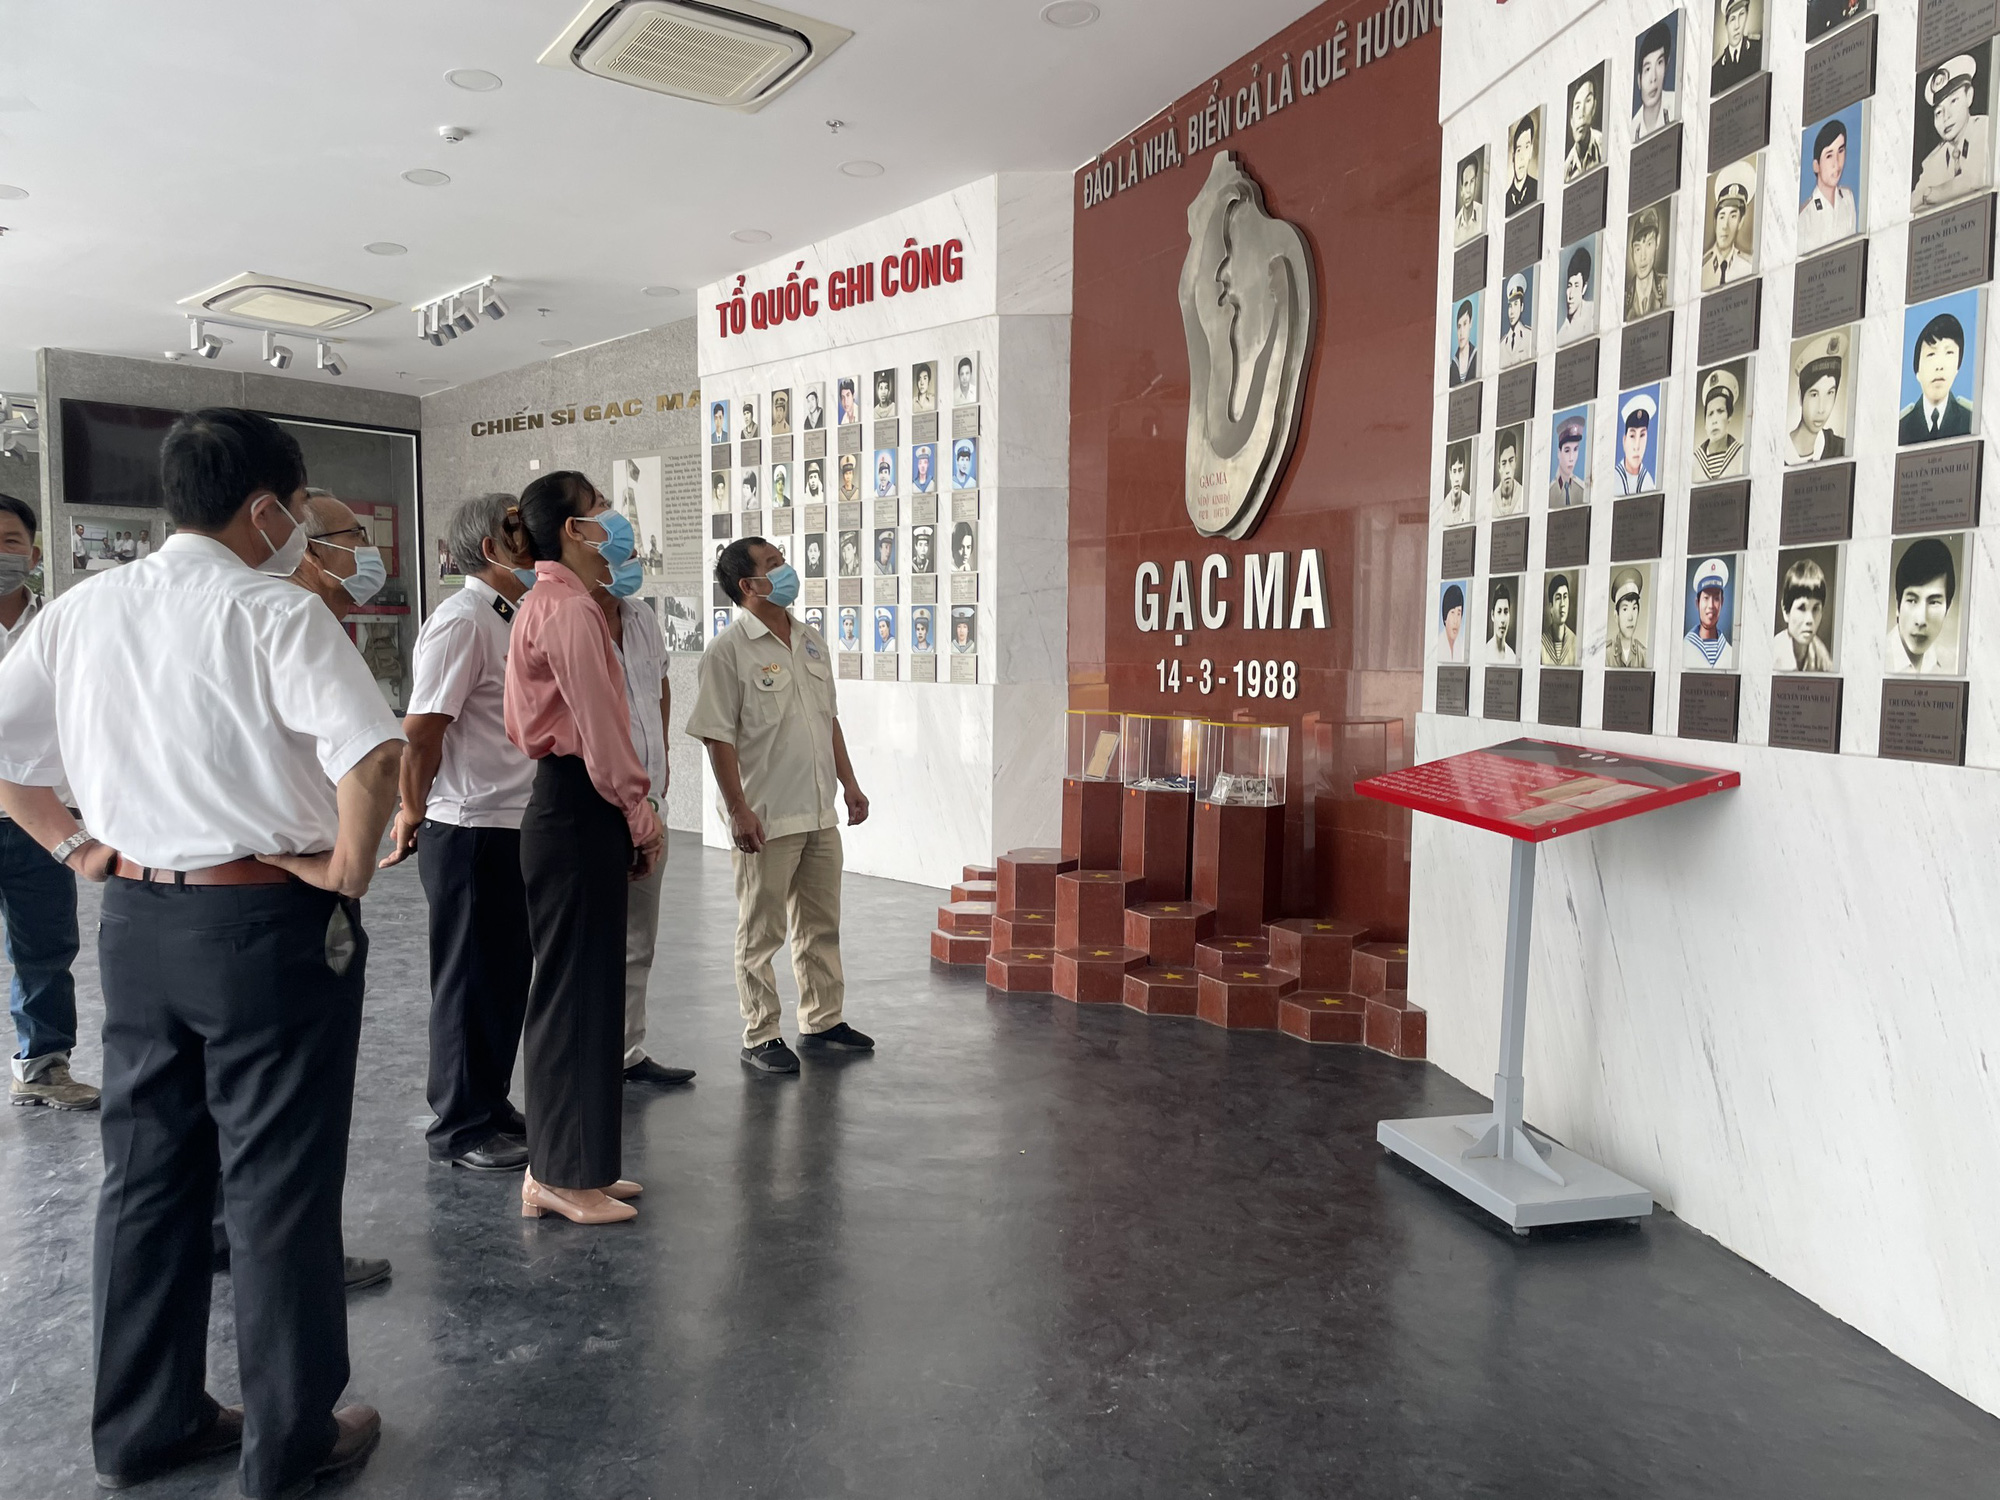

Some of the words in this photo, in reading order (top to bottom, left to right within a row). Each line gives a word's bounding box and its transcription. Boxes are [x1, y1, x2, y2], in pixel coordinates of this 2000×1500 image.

[1083, 153, 1114, 209] ĐẢO
[1117, 137, 1139, 191] LÀ
[1188, 78, 1232, 156] BIỂN
[1235, 62, 1262, 131] CẢ
[1266, 52, 1294, 116] LÀ
[1300, 20, 1349, 96] QUÊ
[715, 274, 747, 338] TỔ
[751, 260, 819, 330] QUỐC
[827, 261, 875, 312] GHI
[881, 237, 964, 297] CÔNG
[471, 405, 545, 437] CHIẾN
[551, 402, 578, 426] SĨ
[583, 397, 643, 426] GẠC
[656, 389, 702, 414] MA
[1134, 553, 1231, 647] GẠC
[1243, 548, 1330, 630] MA
